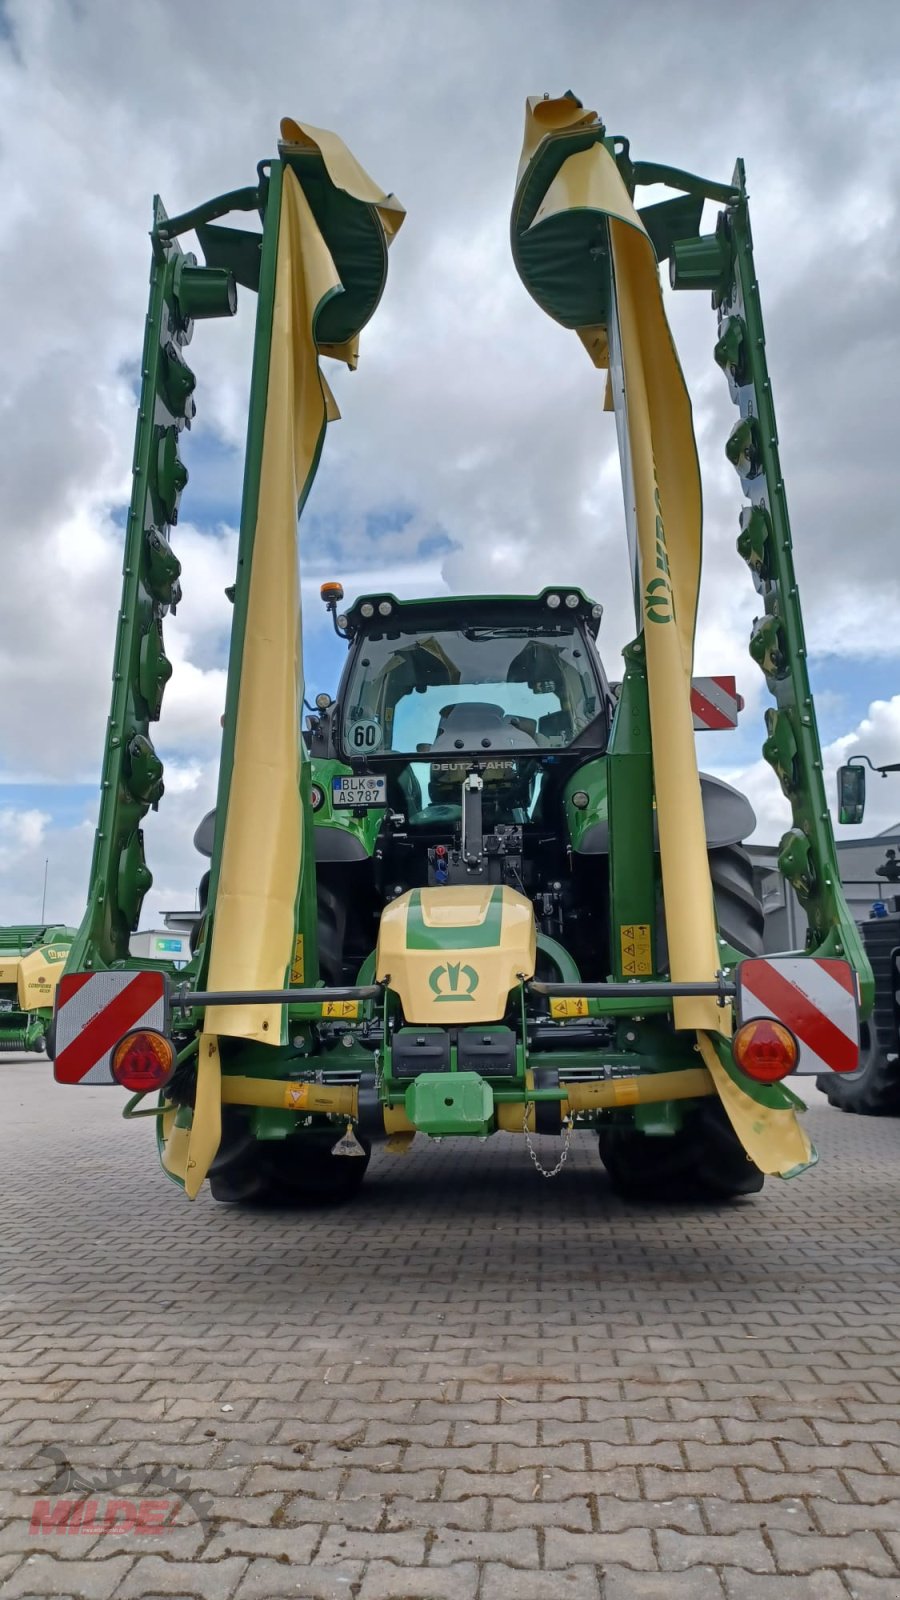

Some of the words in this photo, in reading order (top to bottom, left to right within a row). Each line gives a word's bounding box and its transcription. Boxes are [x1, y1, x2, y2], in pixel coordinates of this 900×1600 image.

[354, 725, 376, 747] 60
[432, 761, 513, 771] DEUTZ-FAHR
[342, 779, 366, 791] BLK
[339, 791, 354, 803] AS
[357, 790, 380, 802] 787
